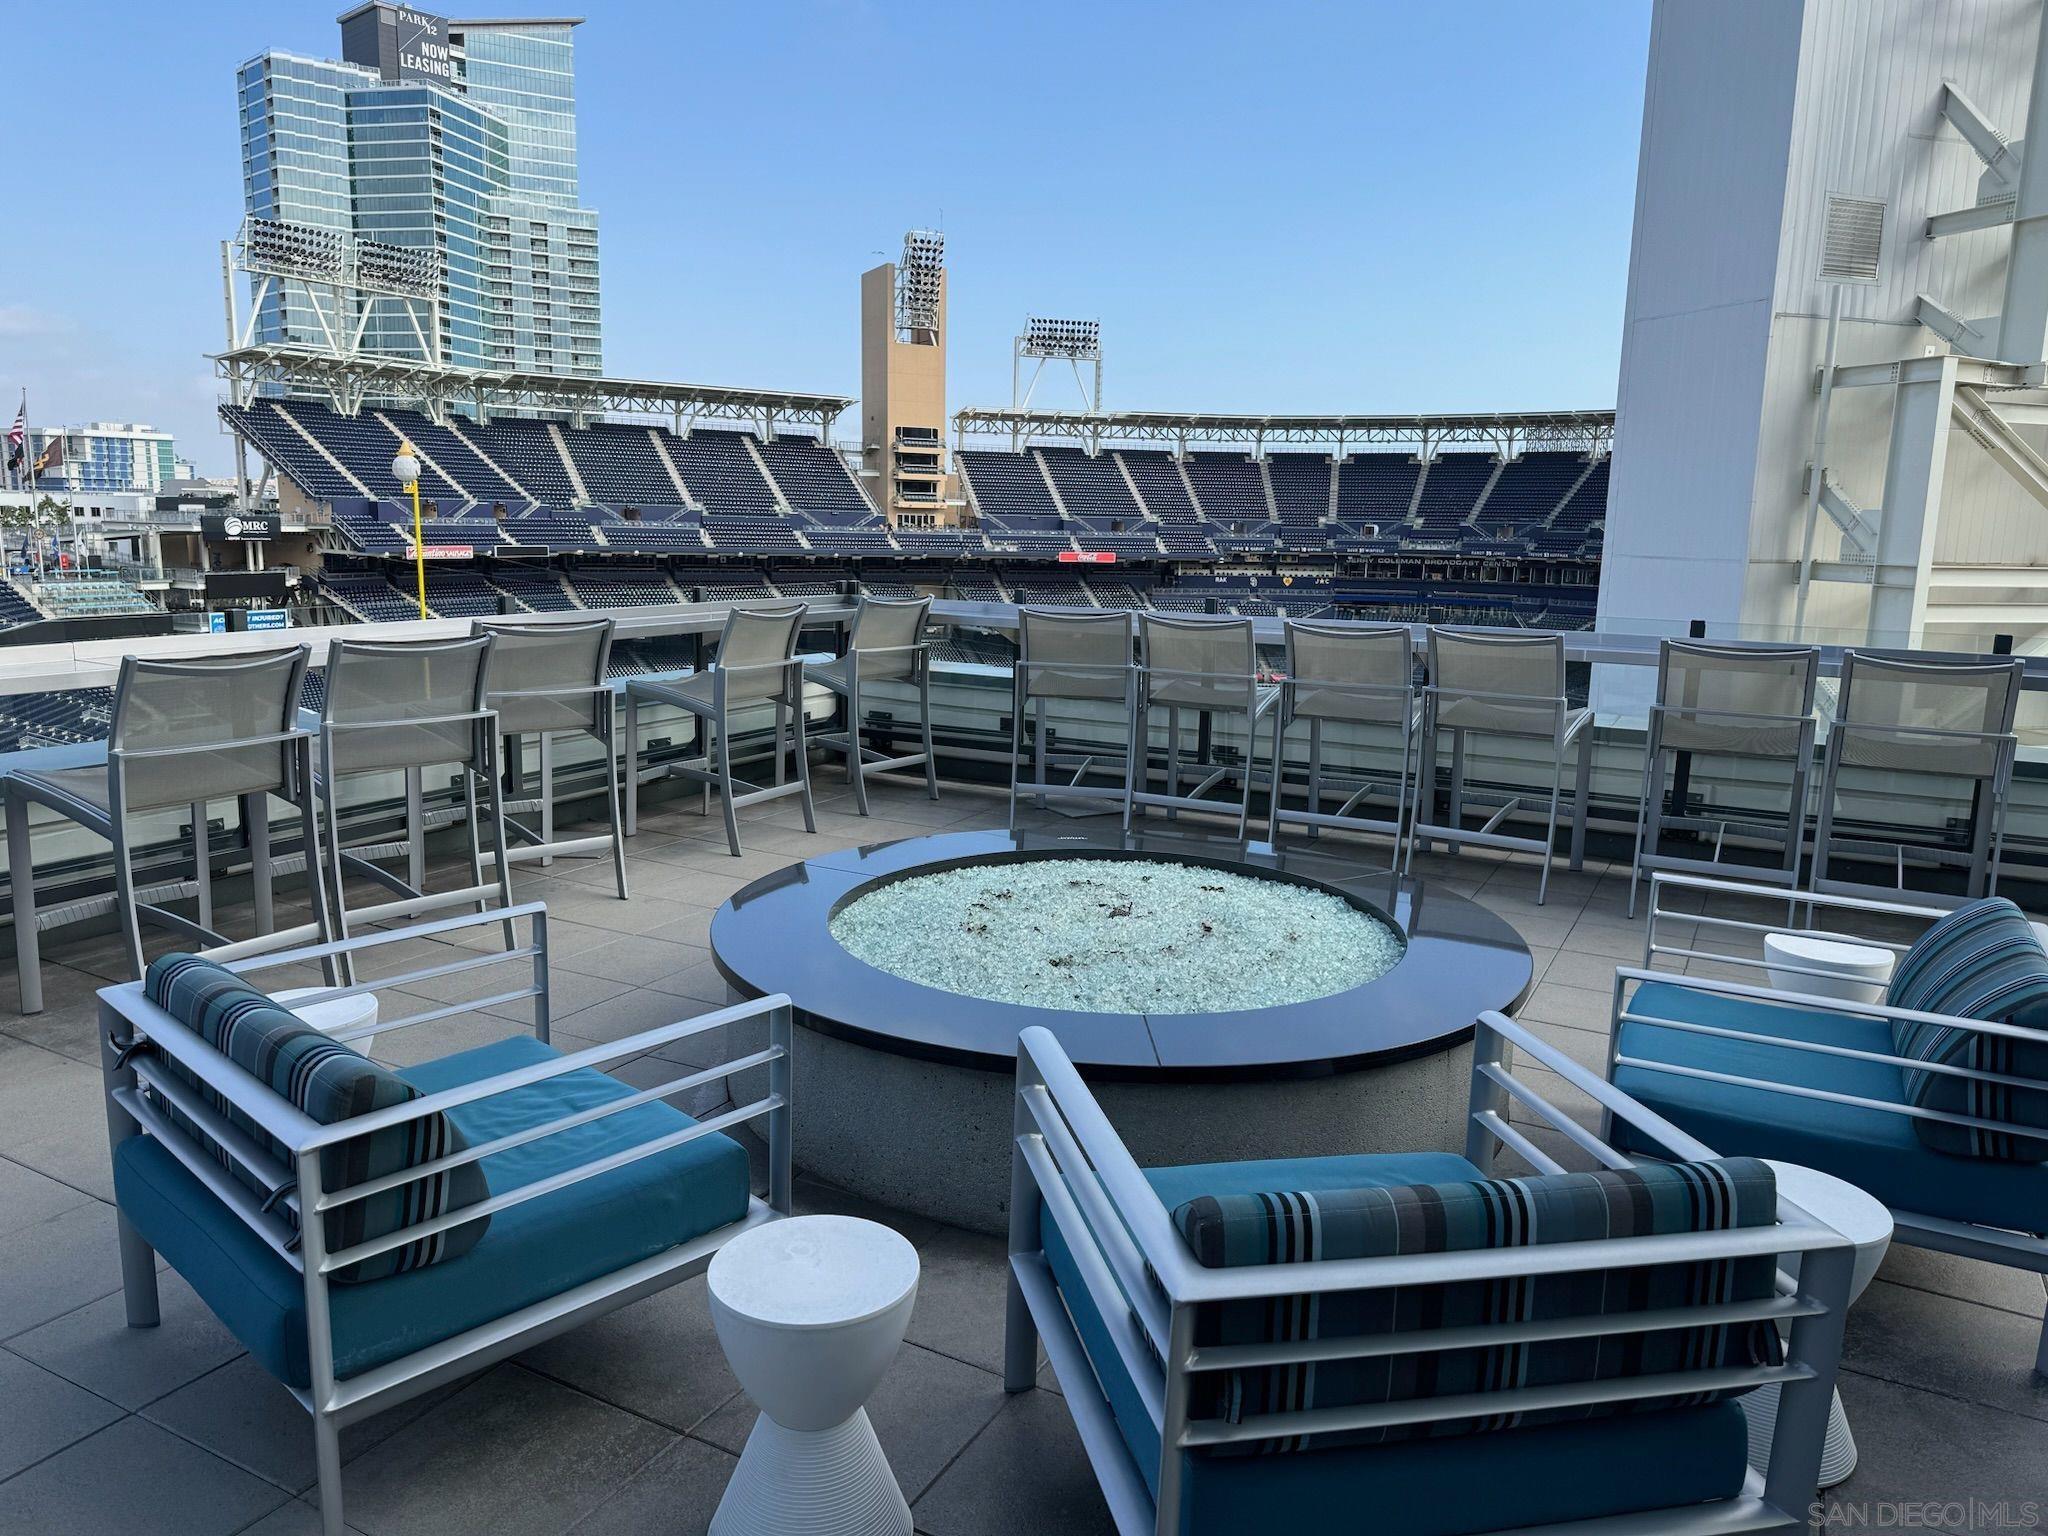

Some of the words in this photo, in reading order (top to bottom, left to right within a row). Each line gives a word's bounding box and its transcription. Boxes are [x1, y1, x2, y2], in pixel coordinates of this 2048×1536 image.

[400, 11, 429, 27] PARK
[426, 24, 438, 36] 12
[421, 41, 448, 61] NOW
[400, 52, 450, 78] LEASING
[242, 521, 269, 531] MRC
[1346, 556, 1374, 564] JERRY
[1483, 560, 1518, 568] CENTER
[251, 614, 284, 622] INJURED?
[247, 622, 285, 630] OTHERS.COM
